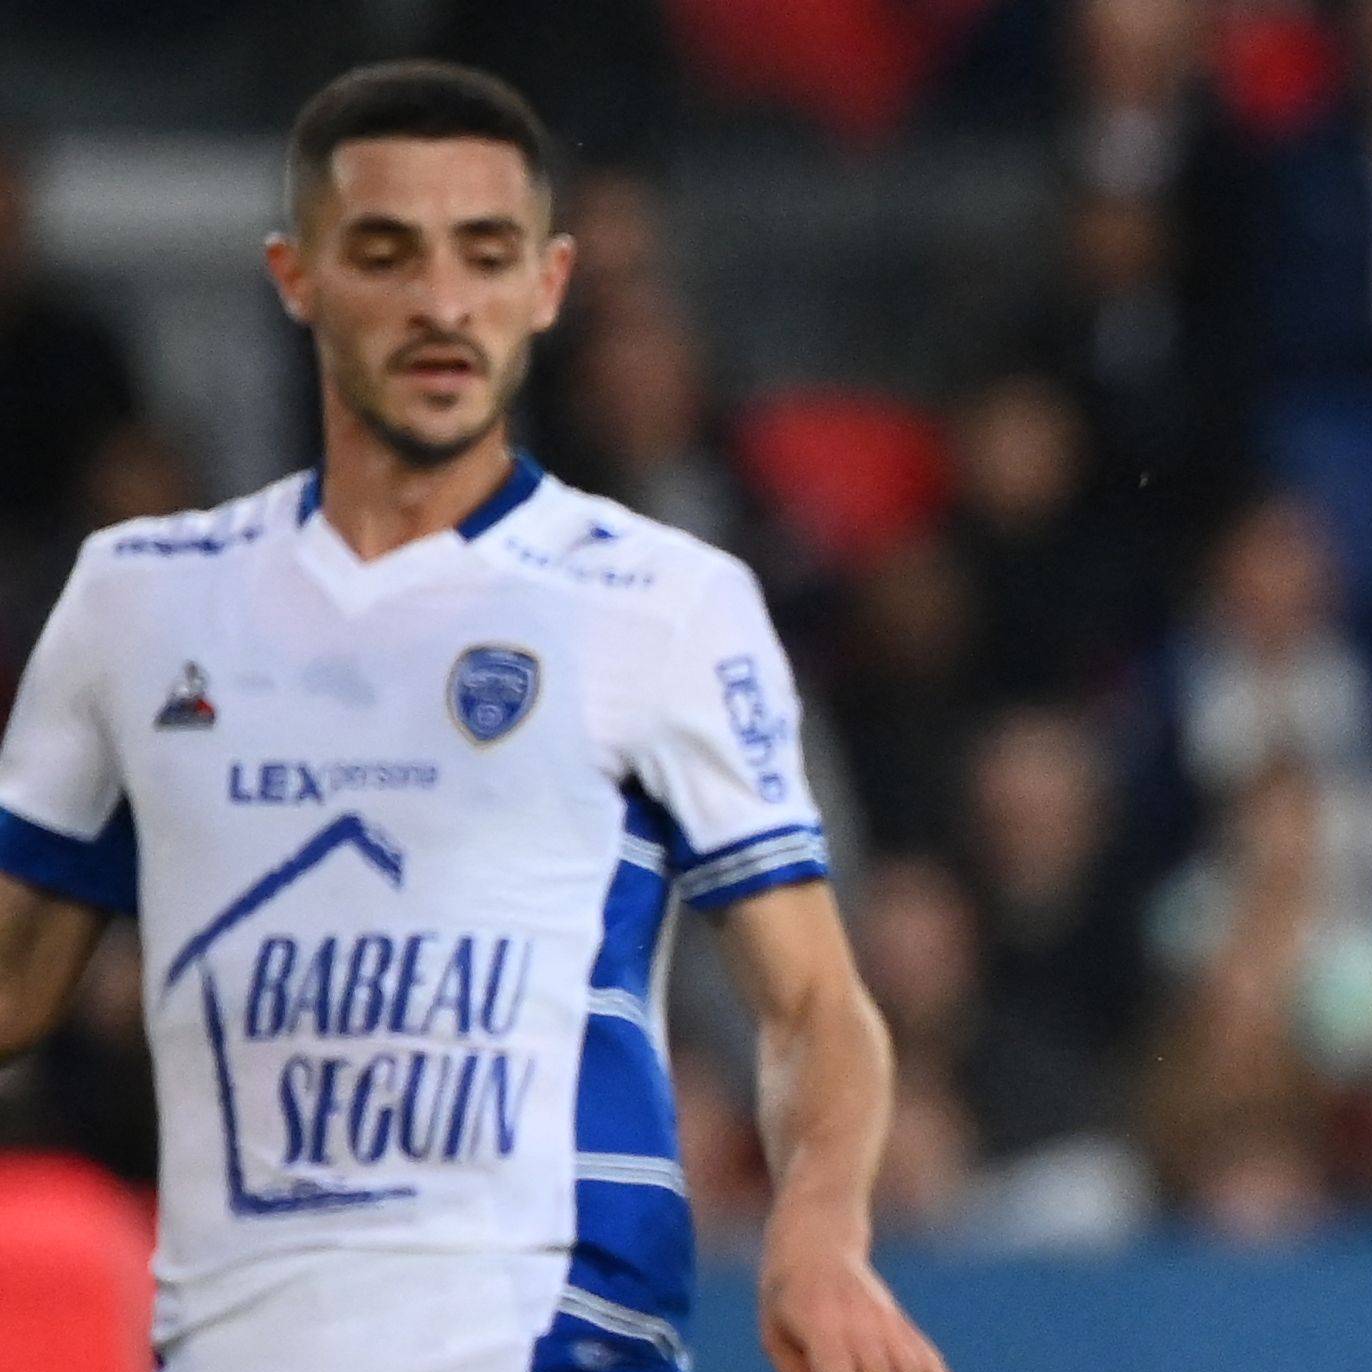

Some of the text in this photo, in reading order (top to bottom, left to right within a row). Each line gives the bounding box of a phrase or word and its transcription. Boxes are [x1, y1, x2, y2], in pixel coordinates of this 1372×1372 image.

[229, 762, 323, 804] LEX
[246, 933, 529, 1040] BABEAU
[279, 1050, 535, 1167] SEGUIN
